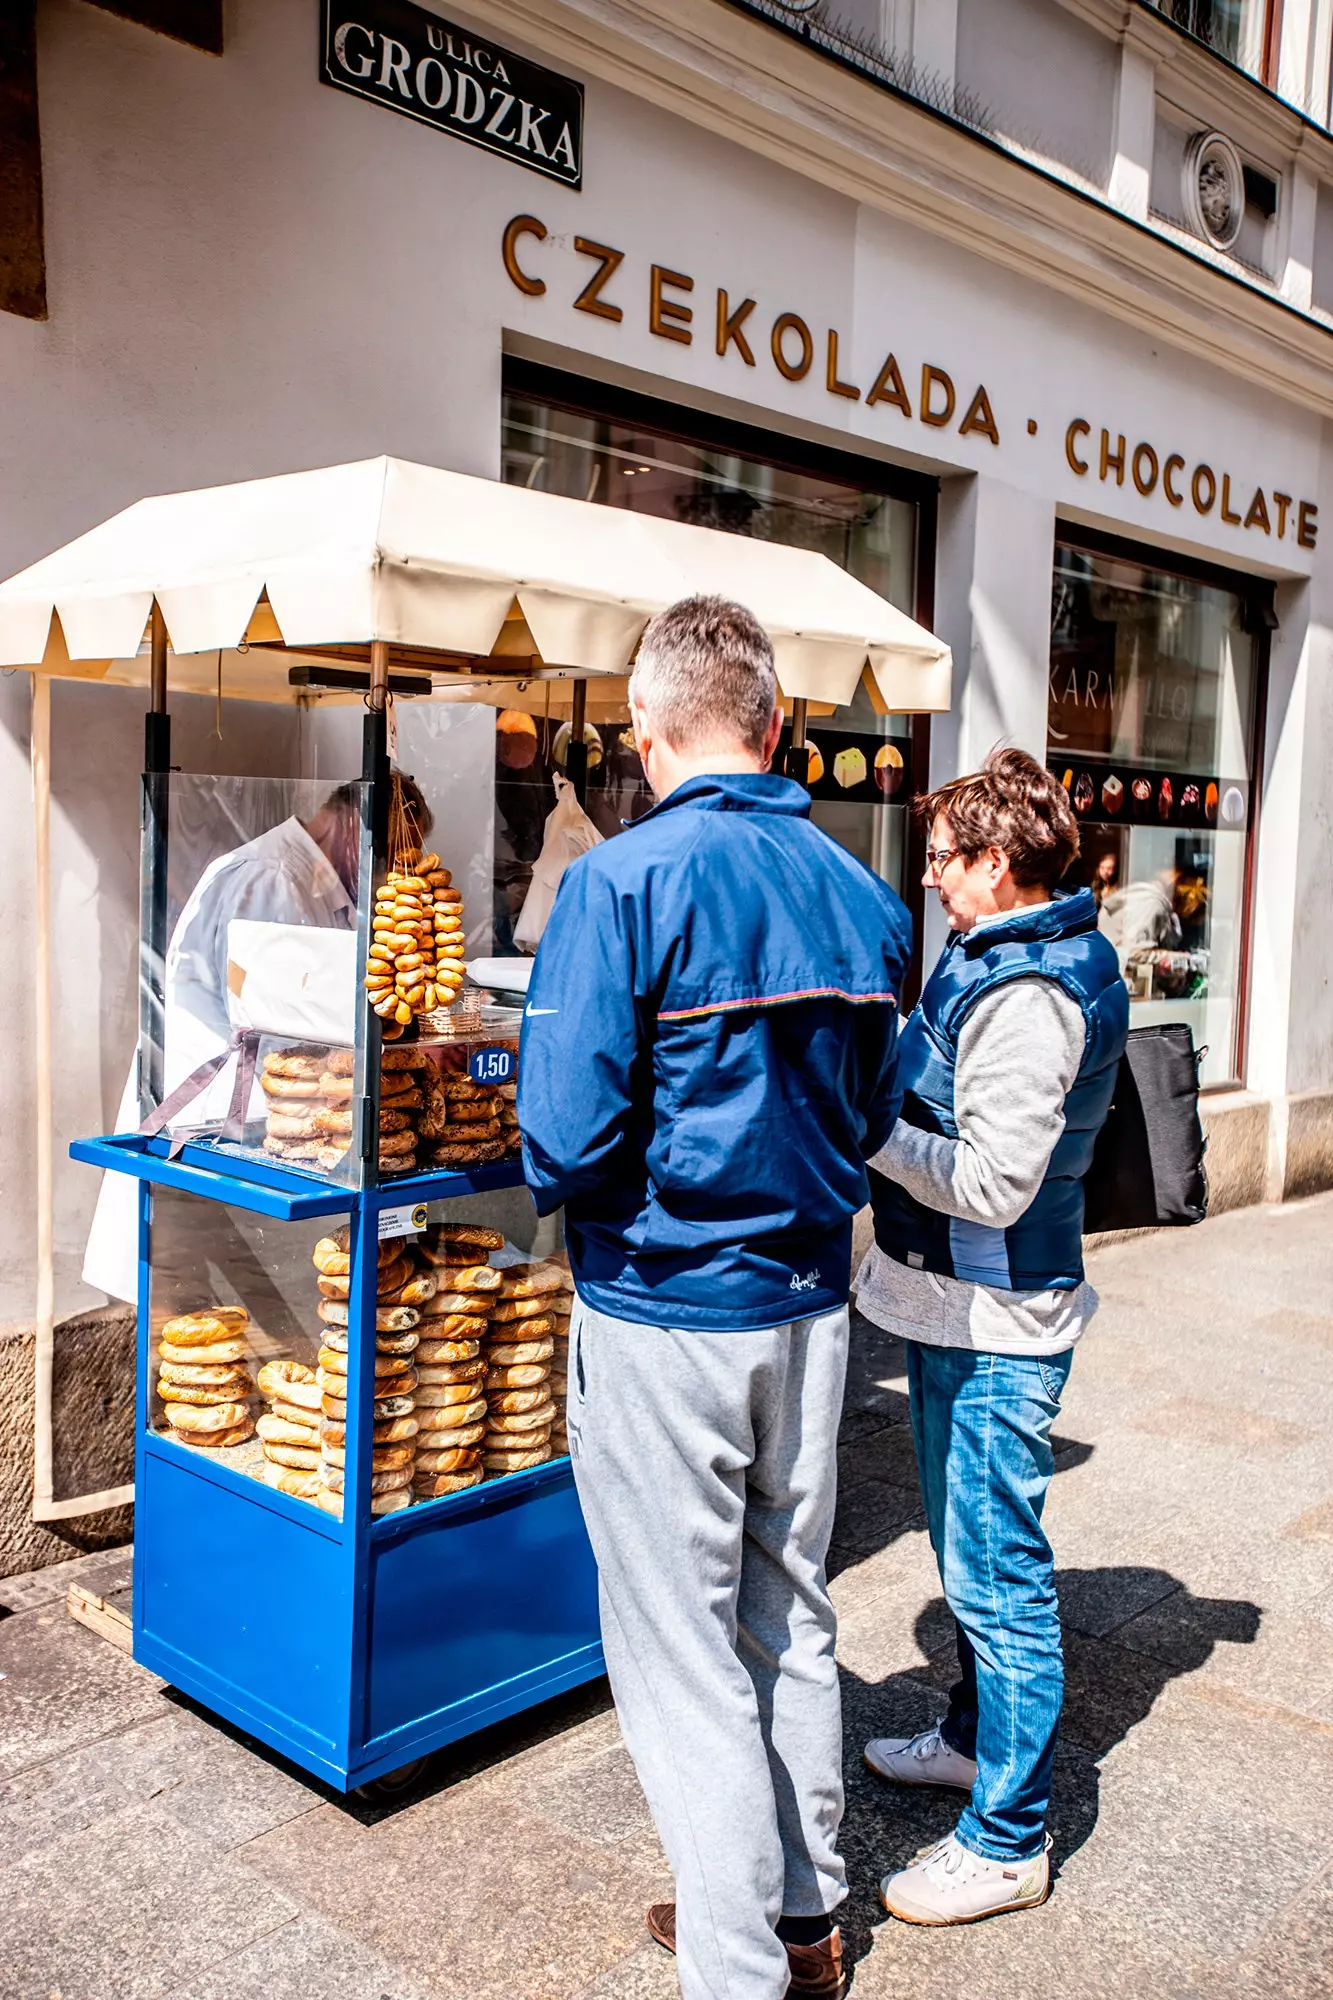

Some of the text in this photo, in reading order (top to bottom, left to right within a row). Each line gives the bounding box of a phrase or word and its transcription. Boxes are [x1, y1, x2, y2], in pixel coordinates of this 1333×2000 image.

[425, 23, 511, 85] ULICA
[334, 22, 577, 172] GRODZKA
[502, 213, 999, 446] CZEKOLADA
[1065, 418, 1319, 549] CHOCOLATE
[1049, 664, 1188, 721] KARMLLO
[476, 1053, 510, 1079] 1,50
